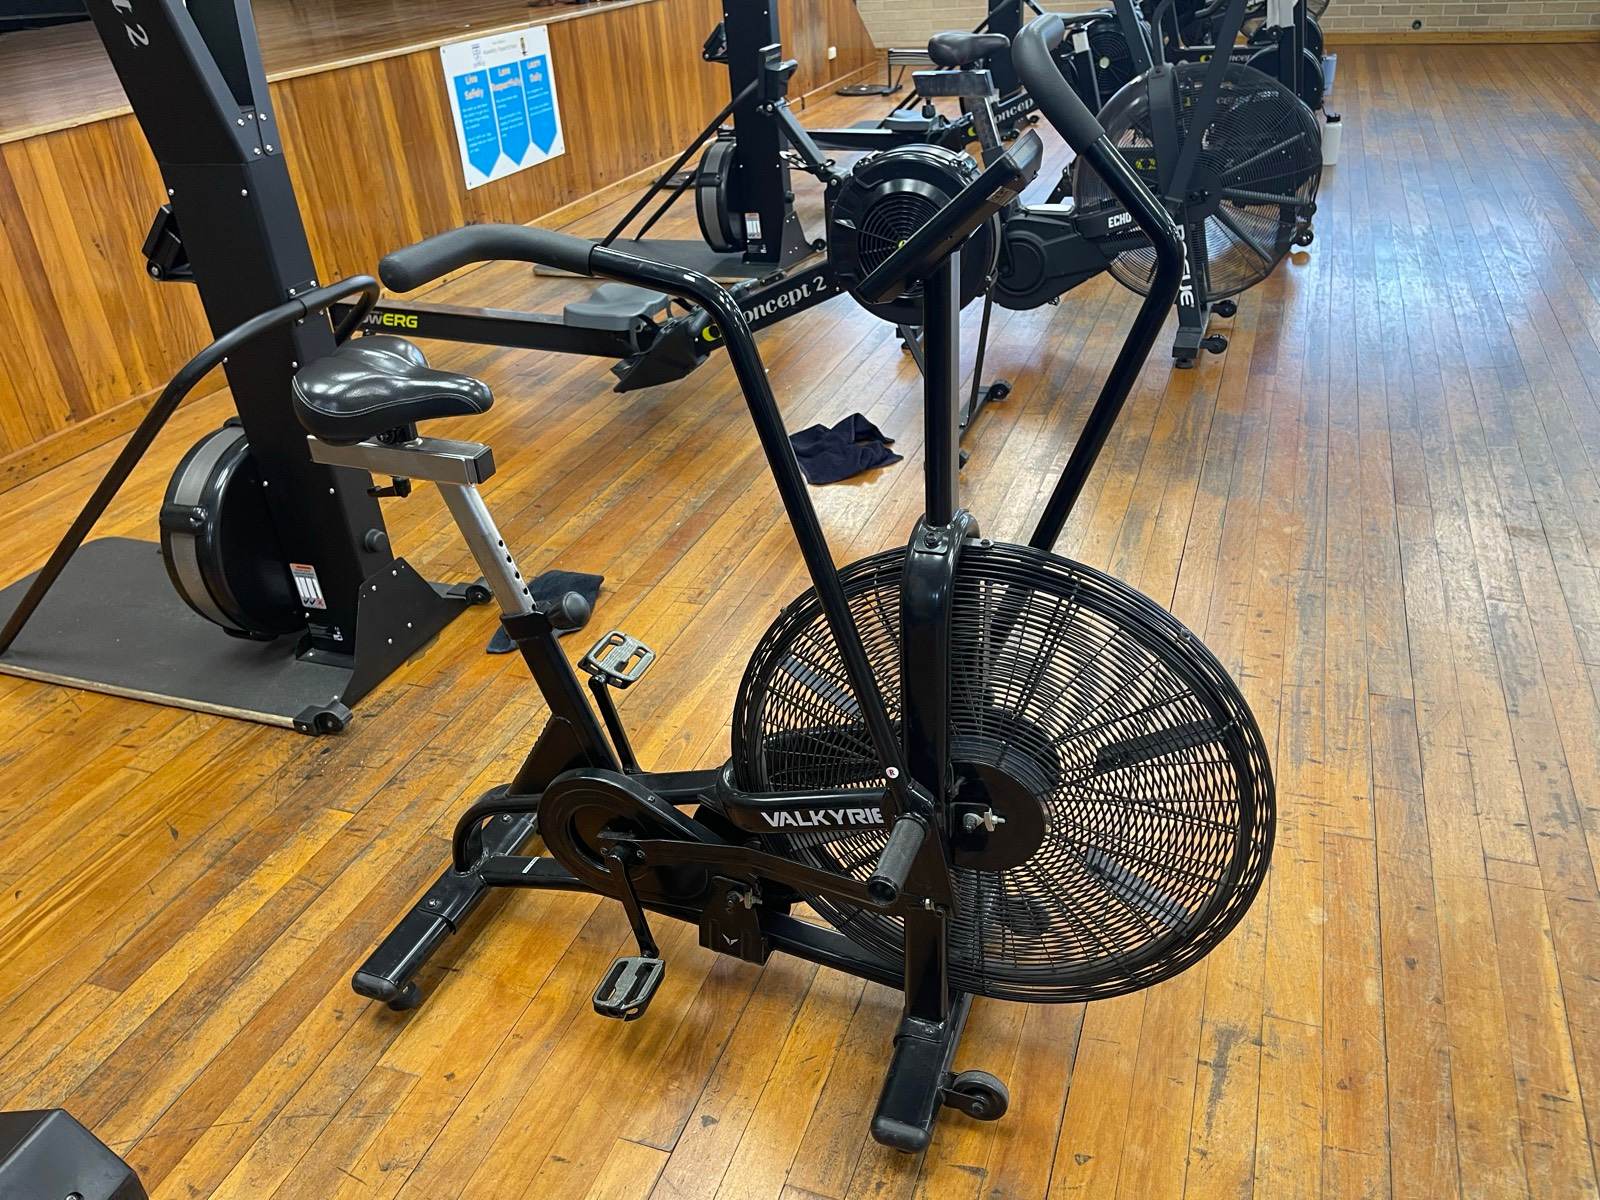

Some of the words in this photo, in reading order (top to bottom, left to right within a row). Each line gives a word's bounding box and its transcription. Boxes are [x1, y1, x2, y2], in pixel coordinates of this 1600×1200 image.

[124, 23, 150, 48] 2
[1107, 211, 1132, 229] ECHO
[812, 275, 827, 292] 2
[760, 807, 885, 828] VALKYRIE
